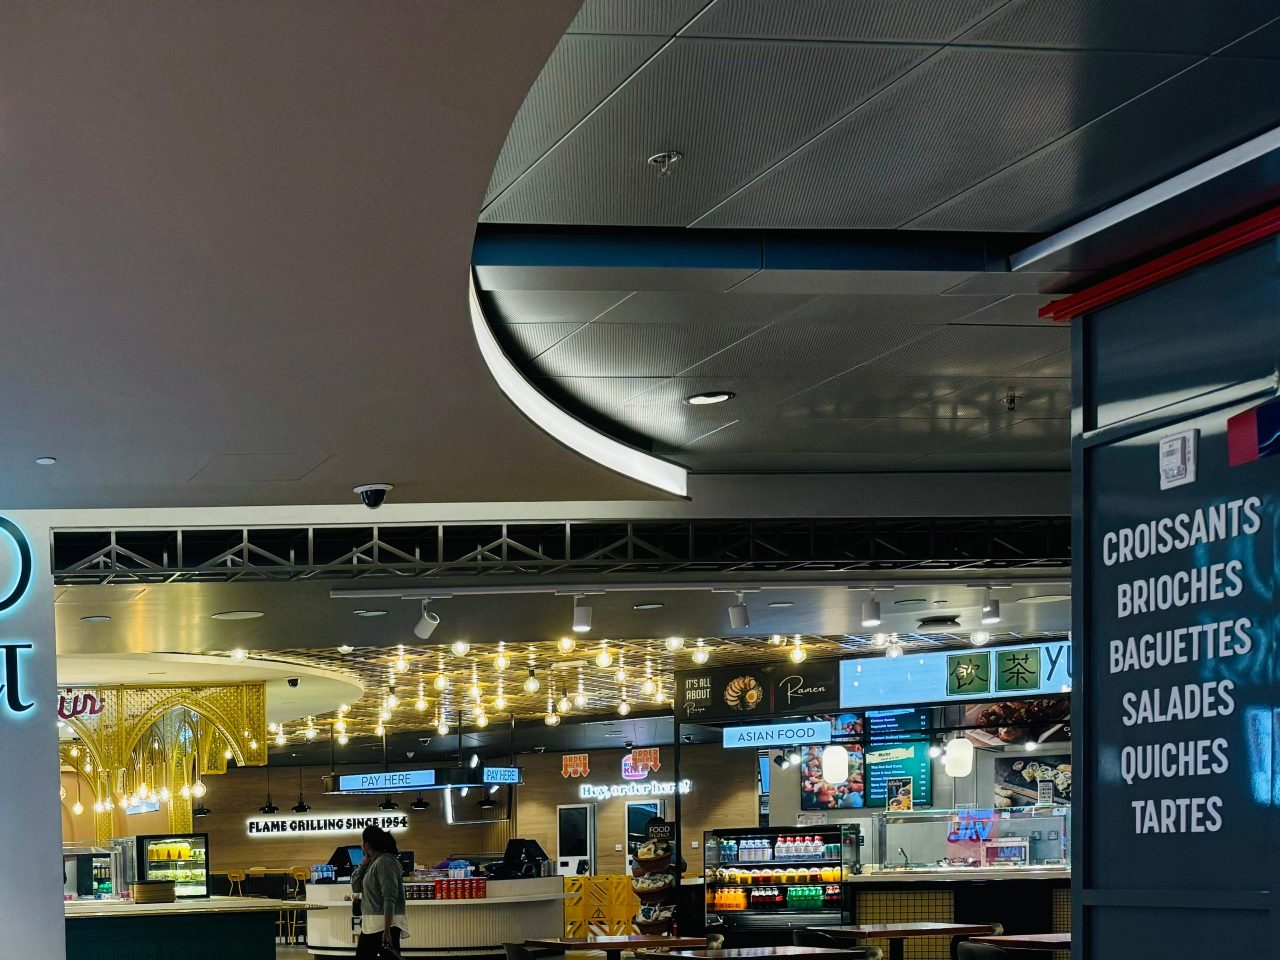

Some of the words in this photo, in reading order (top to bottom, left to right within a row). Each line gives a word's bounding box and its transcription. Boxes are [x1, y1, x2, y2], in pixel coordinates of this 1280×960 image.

[1103, 496, 1261, 567] CROISSANTS
[1117, 559, 1244, 619] BRIOCHES
[1109, 617, 1253, 674] BAGUETTES
[685, 678, 699, 689] IT'S
[699, 678, 711, 688] ALL
[779, 675, 827, 705] Ramen
[686, 689, 711, 700] ABOUT
[1122, 679, 1236, 726] SALADES
[737, 730, 774, 742] ASIAN
[777, 727, 816, 740] FOOD
[564, 755, 587, 763] ORDER
[632, 749, 658, 757] ORDER
[1121, 737, 1230, 785] QUICHES
[361, 776, 380, 787] PAY
[384, 773, 411, 785] HERE
[487, 770, 498, 781] PAY
[499, 769, 516, 781] HERE
[611, 782, 651, 796] order
[1131, 795, 1224, 835] TARTES
[249, 821, 287, 833] FLAME
[289, 818, 344, 831] GRILLING
[346, 817, 379, 830] SINCE
[381, 815, 408, 828] 1954
[649, 826, 671, 834] FOOD
